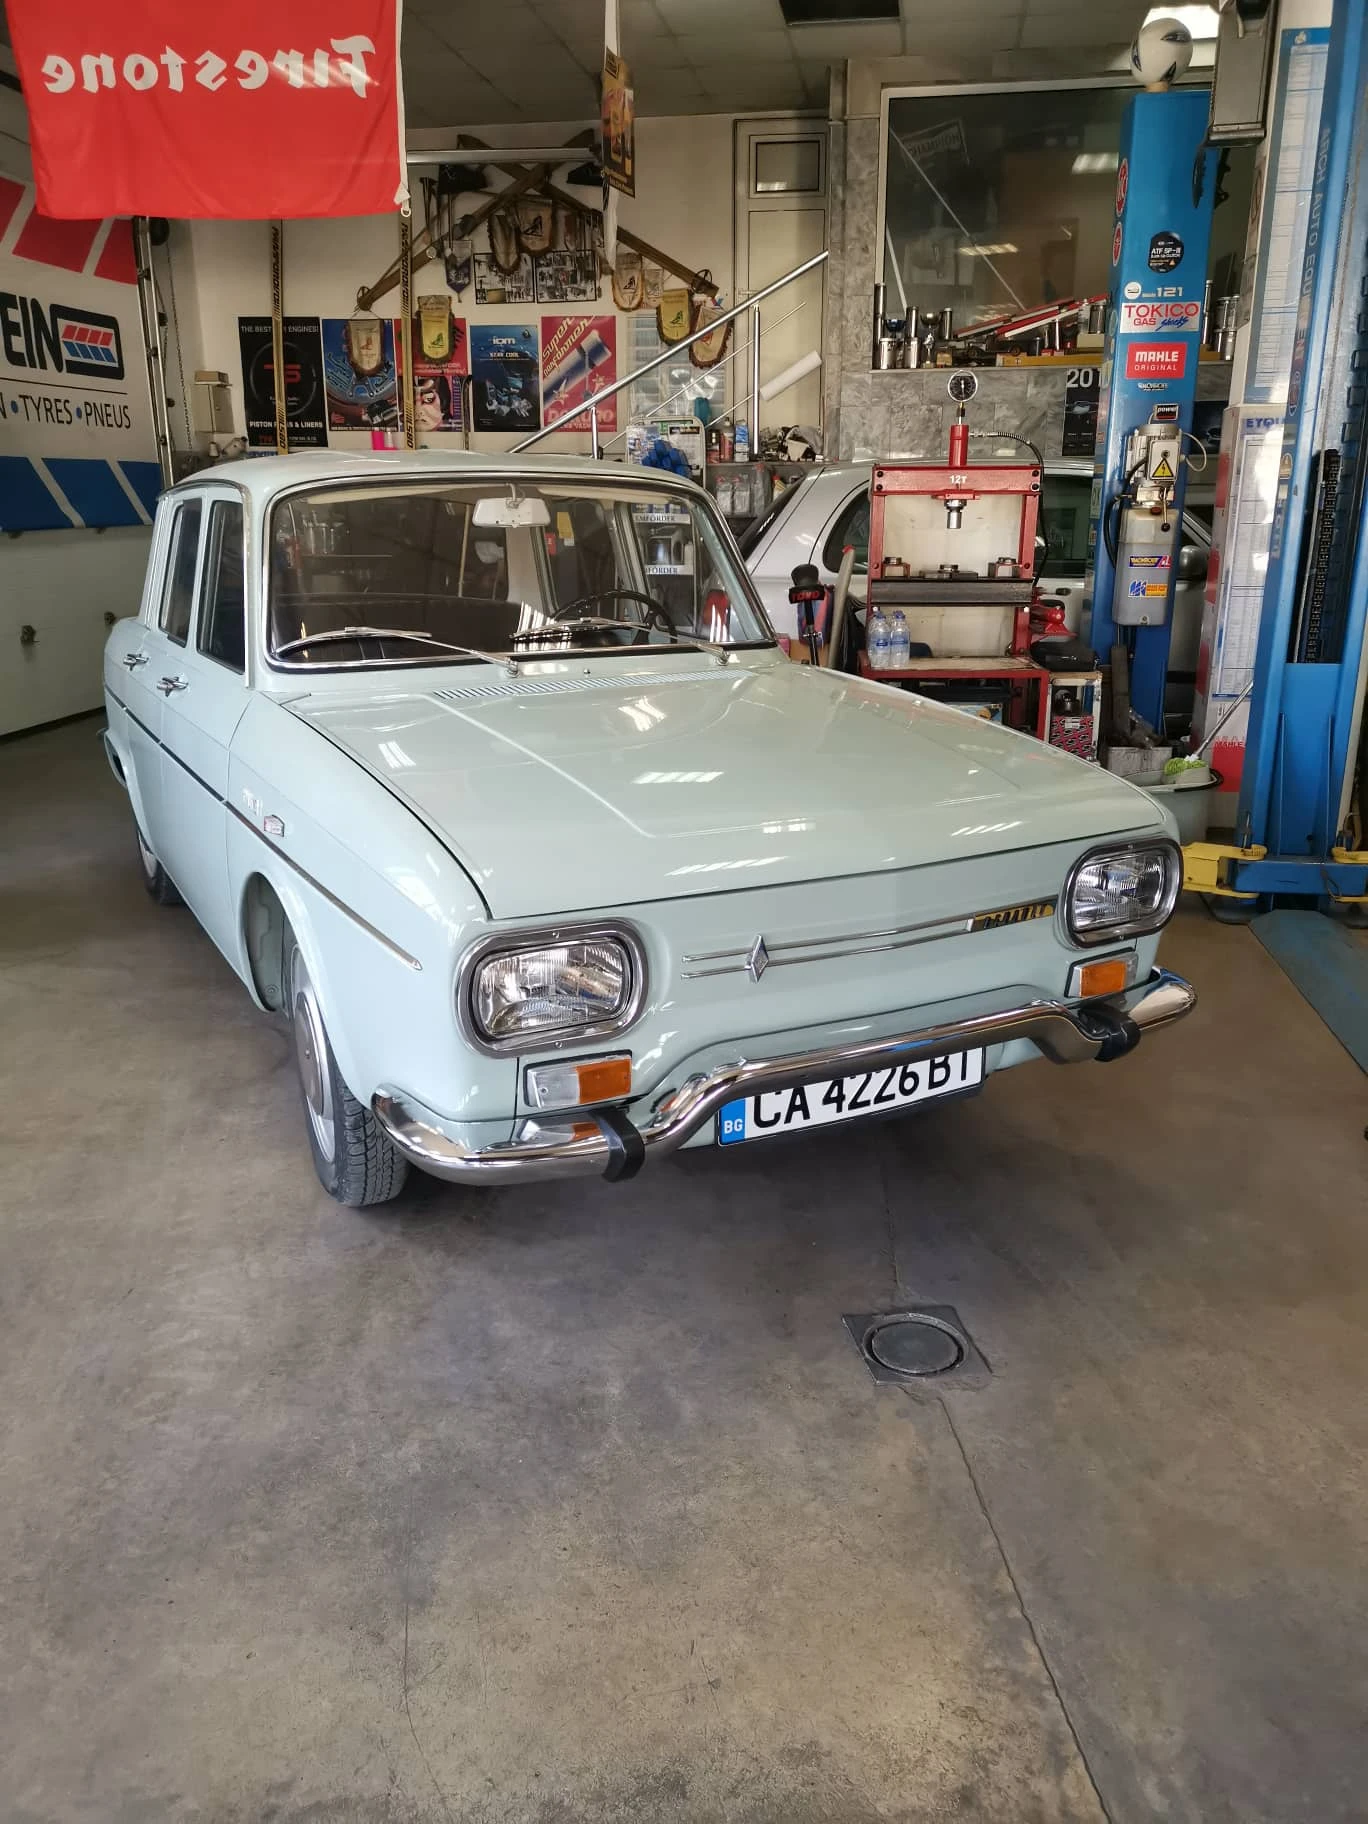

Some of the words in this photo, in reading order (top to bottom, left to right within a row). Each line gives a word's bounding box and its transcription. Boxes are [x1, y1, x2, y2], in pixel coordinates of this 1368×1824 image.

[1156, 286, 1183, 297] 121
[1124, 303, 1199, 318] TOKICO
[1134, 318, 1157, 326] GAS
[1135, 351, 1180, 362] MAHLE
[18, 395, 73, 425] TYRES
[84, 401, 131, 429] PNEUS
[753, 1086, 810, 1128] CA
[822, 1065, 920, 1113] 4226
[724, 1119, 743, 1134] BG
